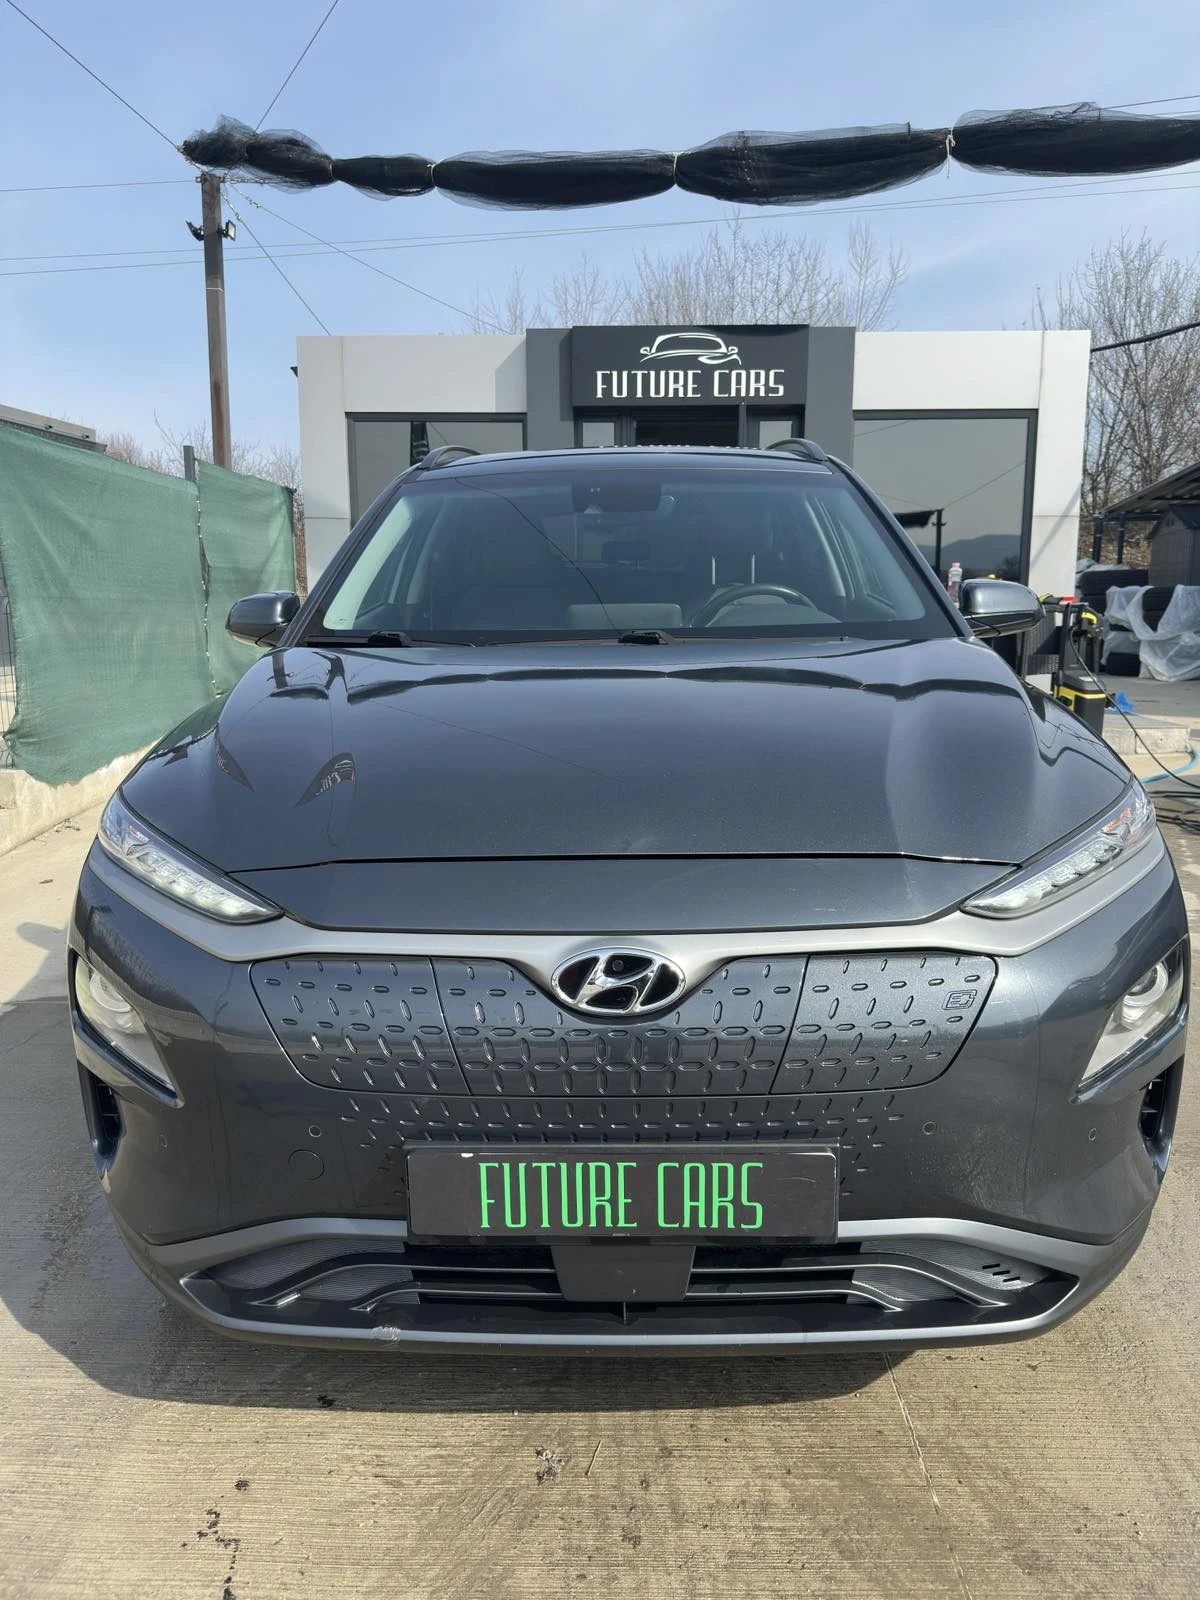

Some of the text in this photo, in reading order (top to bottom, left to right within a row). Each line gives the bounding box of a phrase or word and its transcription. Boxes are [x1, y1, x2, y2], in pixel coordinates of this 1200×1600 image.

[596, 369, 785, 398] FUTURE CARS
[478, 1162, 764, 1229] FUTURE CARS
